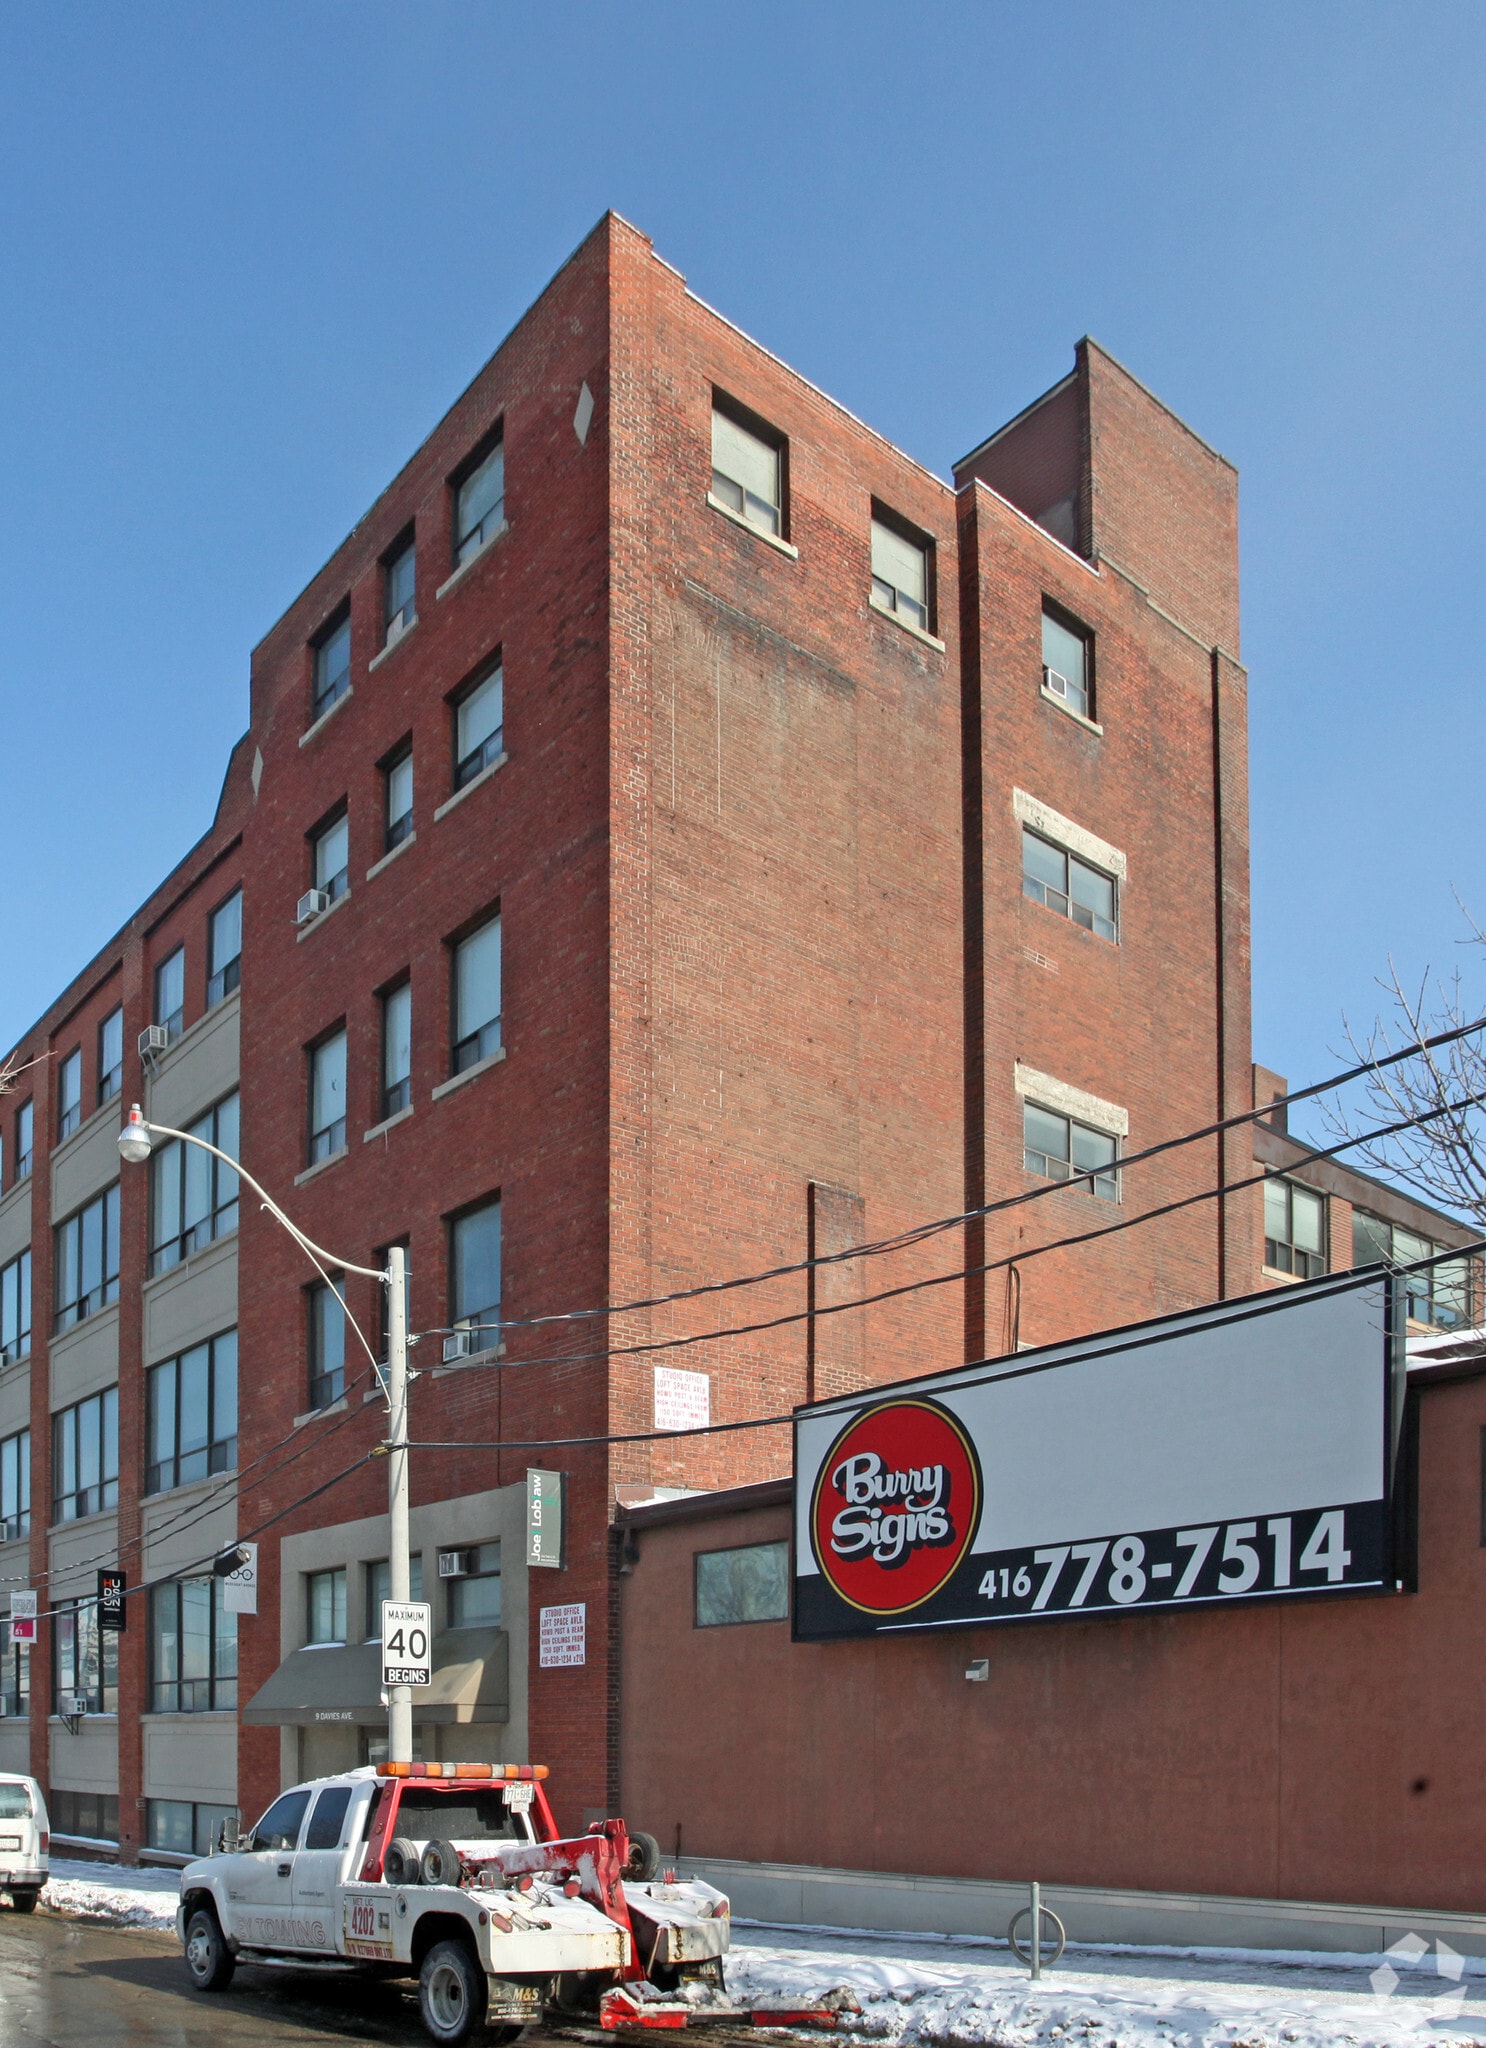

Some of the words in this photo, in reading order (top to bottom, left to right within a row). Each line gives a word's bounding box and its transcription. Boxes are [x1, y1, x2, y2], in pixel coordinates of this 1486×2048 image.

[657, 1379, 670, 1388] LOFT
[673, 1381, 691, 1392] SPACE
[685, 1374, 703, 1384] OFFICE
[832, 1452, 944, 1513] Burry
[530, 1474, 542, 1527] Loblaw
[830, 1505, 950, 1562] Signs
[531, 1530, 542, 1561] Joel
[978, 1566, 1031, 1600] 416
[1031, 1510, 1352, 1611] 778-7514
[388, 1610, 424, 1621] MAXIMUM
[545, 1608, 562, 1618] STUDIO
[563, 1606, 580, 1616] OFFICE
[541, 1618, 552, 1628] LOFT
[553, 1617, 569, 1627] SPACE
[554, 1627, 565, 1635] POST
[572, 1625, 583, 1633] BEAM
[387, 1628, 427, 1660] 40
[541, 1637, 551, 1645] HIGH
[552, 1635, 570, 1645] CEILINGS
[572, 1635, 583, 1643] FROM
[388, 1668, 426, 1683] BEGINS
[315, 1712, 320, 1721] 9
[320, 1712, 340, 1721] DAVIES
[352, 1906, 374, 1936] 4202
[255, 1917, 326, 1946] TOWING
[699, 1963, 717, 1975] M&S
[512, 1987, 540, 2001] M&S
